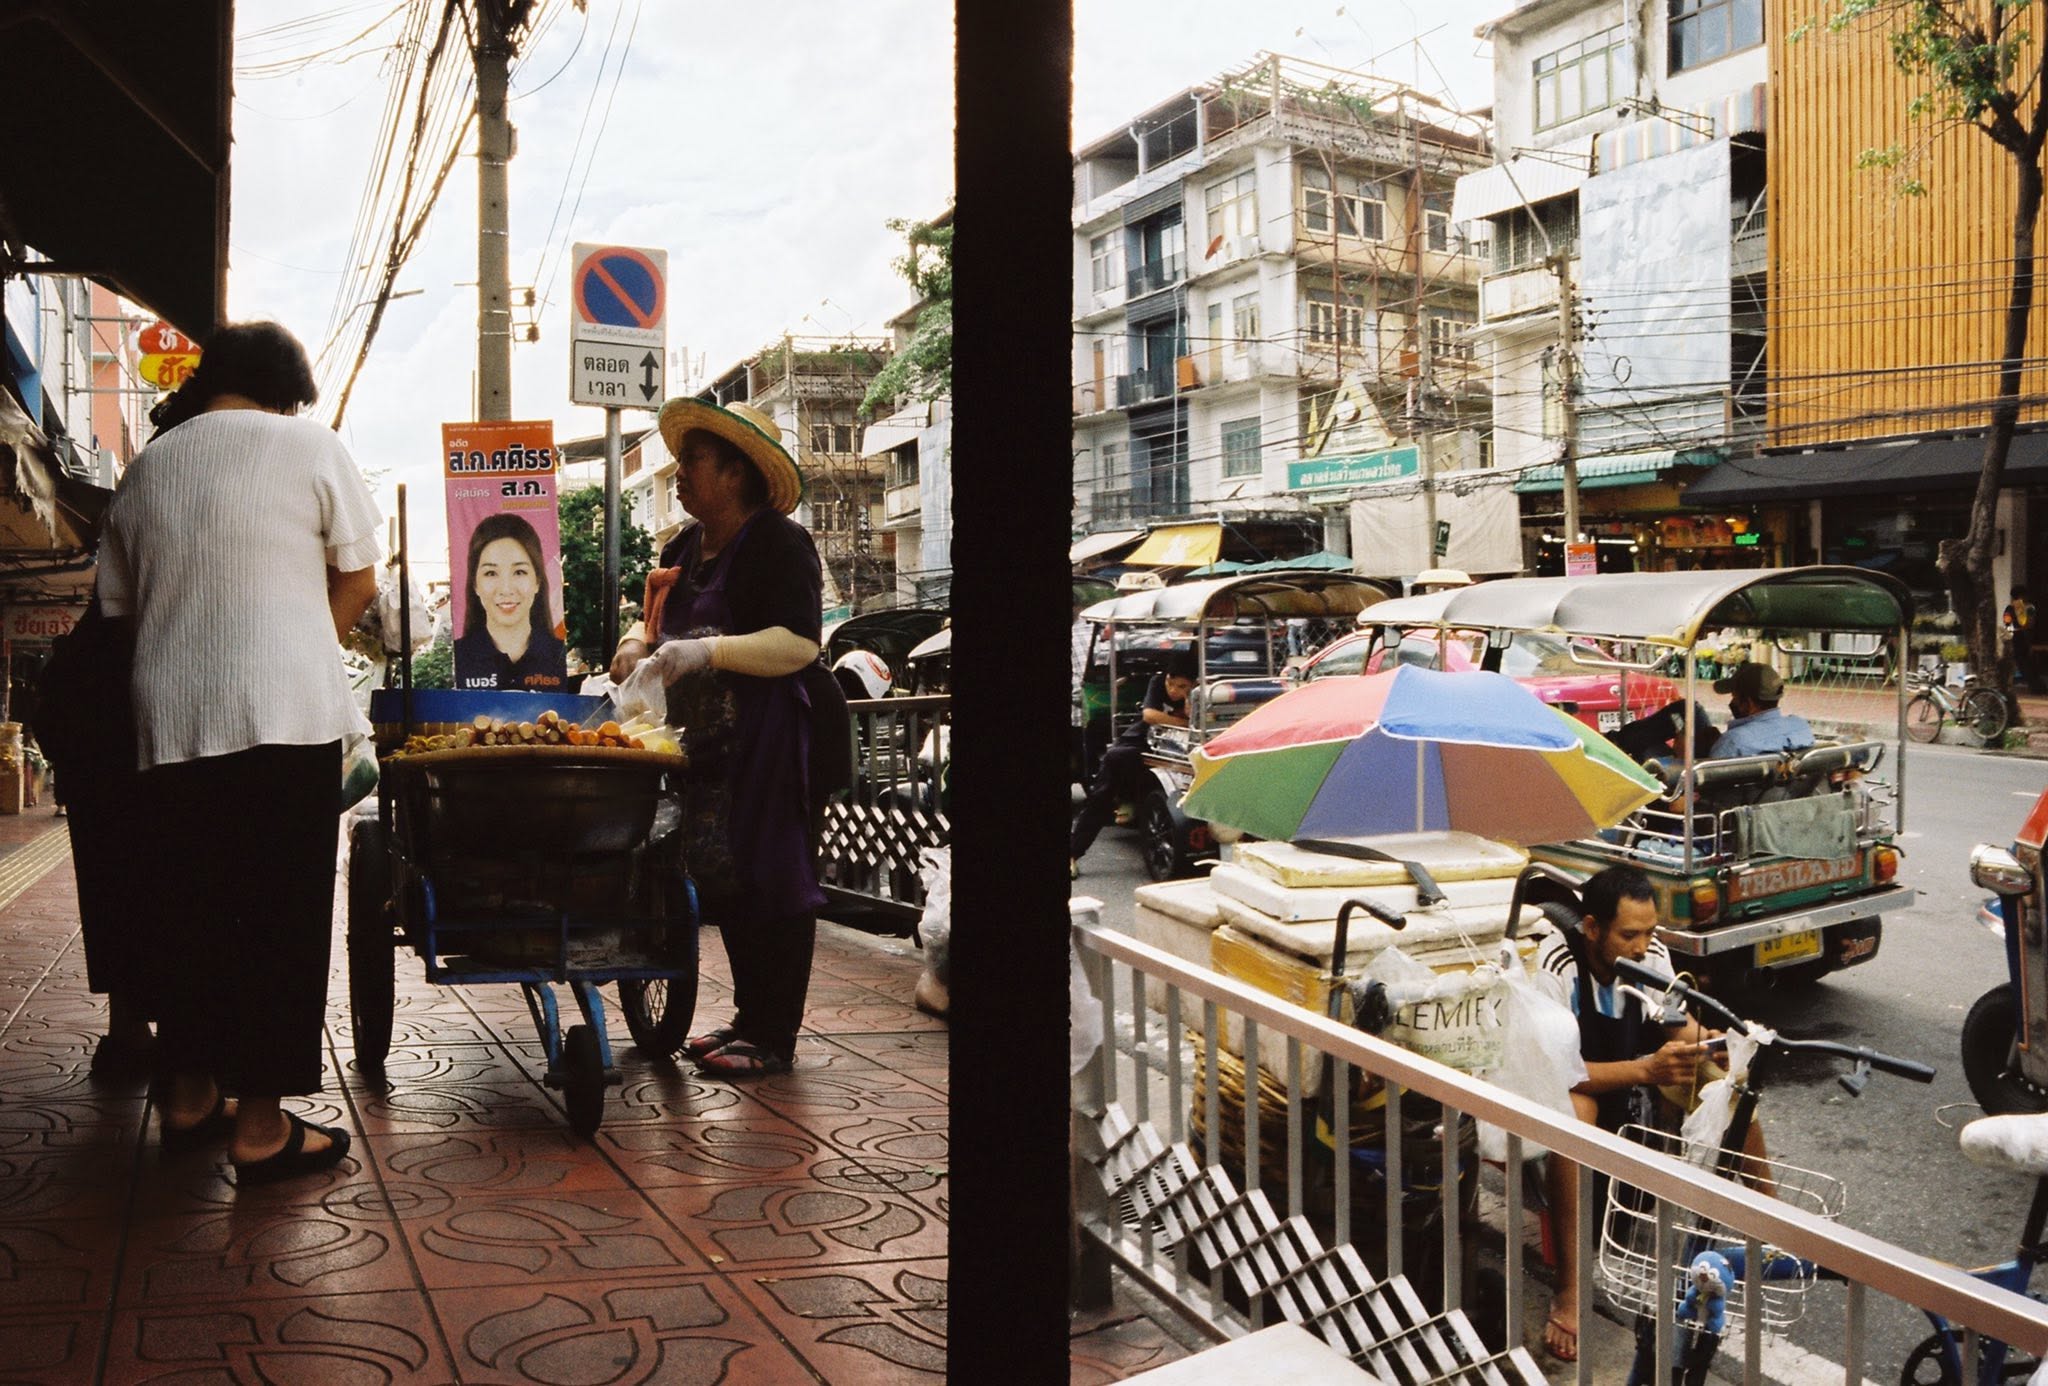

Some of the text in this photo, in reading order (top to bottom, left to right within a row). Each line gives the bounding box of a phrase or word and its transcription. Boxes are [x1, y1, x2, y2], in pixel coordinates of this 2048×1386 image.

[584, 356, 629, 374] ตลอด
[588, 380, 626, 397] เวลา
[449, 443, 553, 473] ส.ก.ศศิธร
[501, 480, 548, 498] ส.ก.
[465, 673, 498, 688] เบอร์
[1738, 856, 1857, 897] THAILAND
